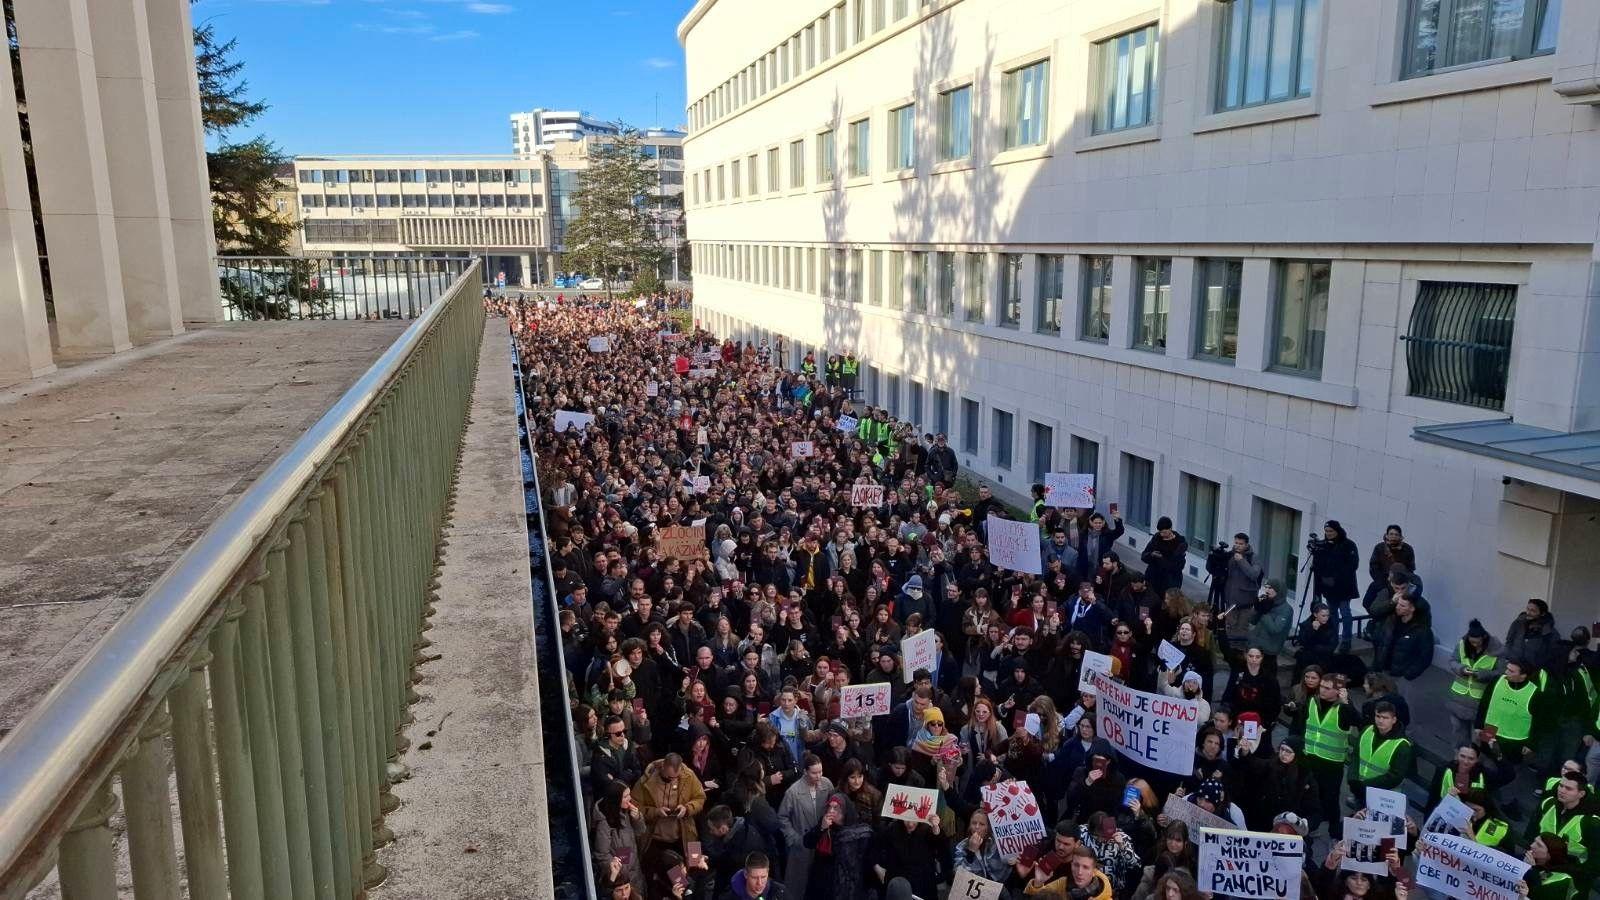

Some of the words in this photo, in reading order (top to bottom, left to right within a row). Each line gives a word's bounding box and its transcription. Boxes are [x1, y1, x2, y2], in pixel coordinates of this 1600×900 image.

[855, 694, 875, 708] 15
[1152, 700, 1197, 722] СЛУЧАЈ
[1103, 699, 1143, 729] РОДИТИ
[1153, 720, 1170, 735] СЕ
[994, 824, 1015, 837] RUKE
[1013, 822, 1025, 834] SU
[1024, 819, 1042, 832] VAM
[1205, 832, 1219, 844] MI
[1226, 836, 1250, 847] SMO
[1256, 841, 1285, 851] OVDE
[1423, 844, 1461, 871] КРВИ
[1424, 833, 1438, 842] НЕ
[1441, 840, 1458, 850] БИ
[1460, 846, 1494, 864] БИЛО
[1496, 860, 1520, 874] ОВЕ
[1260, 861, 1269, 873] U
[1419, 865, 1441, 879] СВЕ
[1446, 873, 1460, 887] ПО
[965, 879, 985, 899] 15
